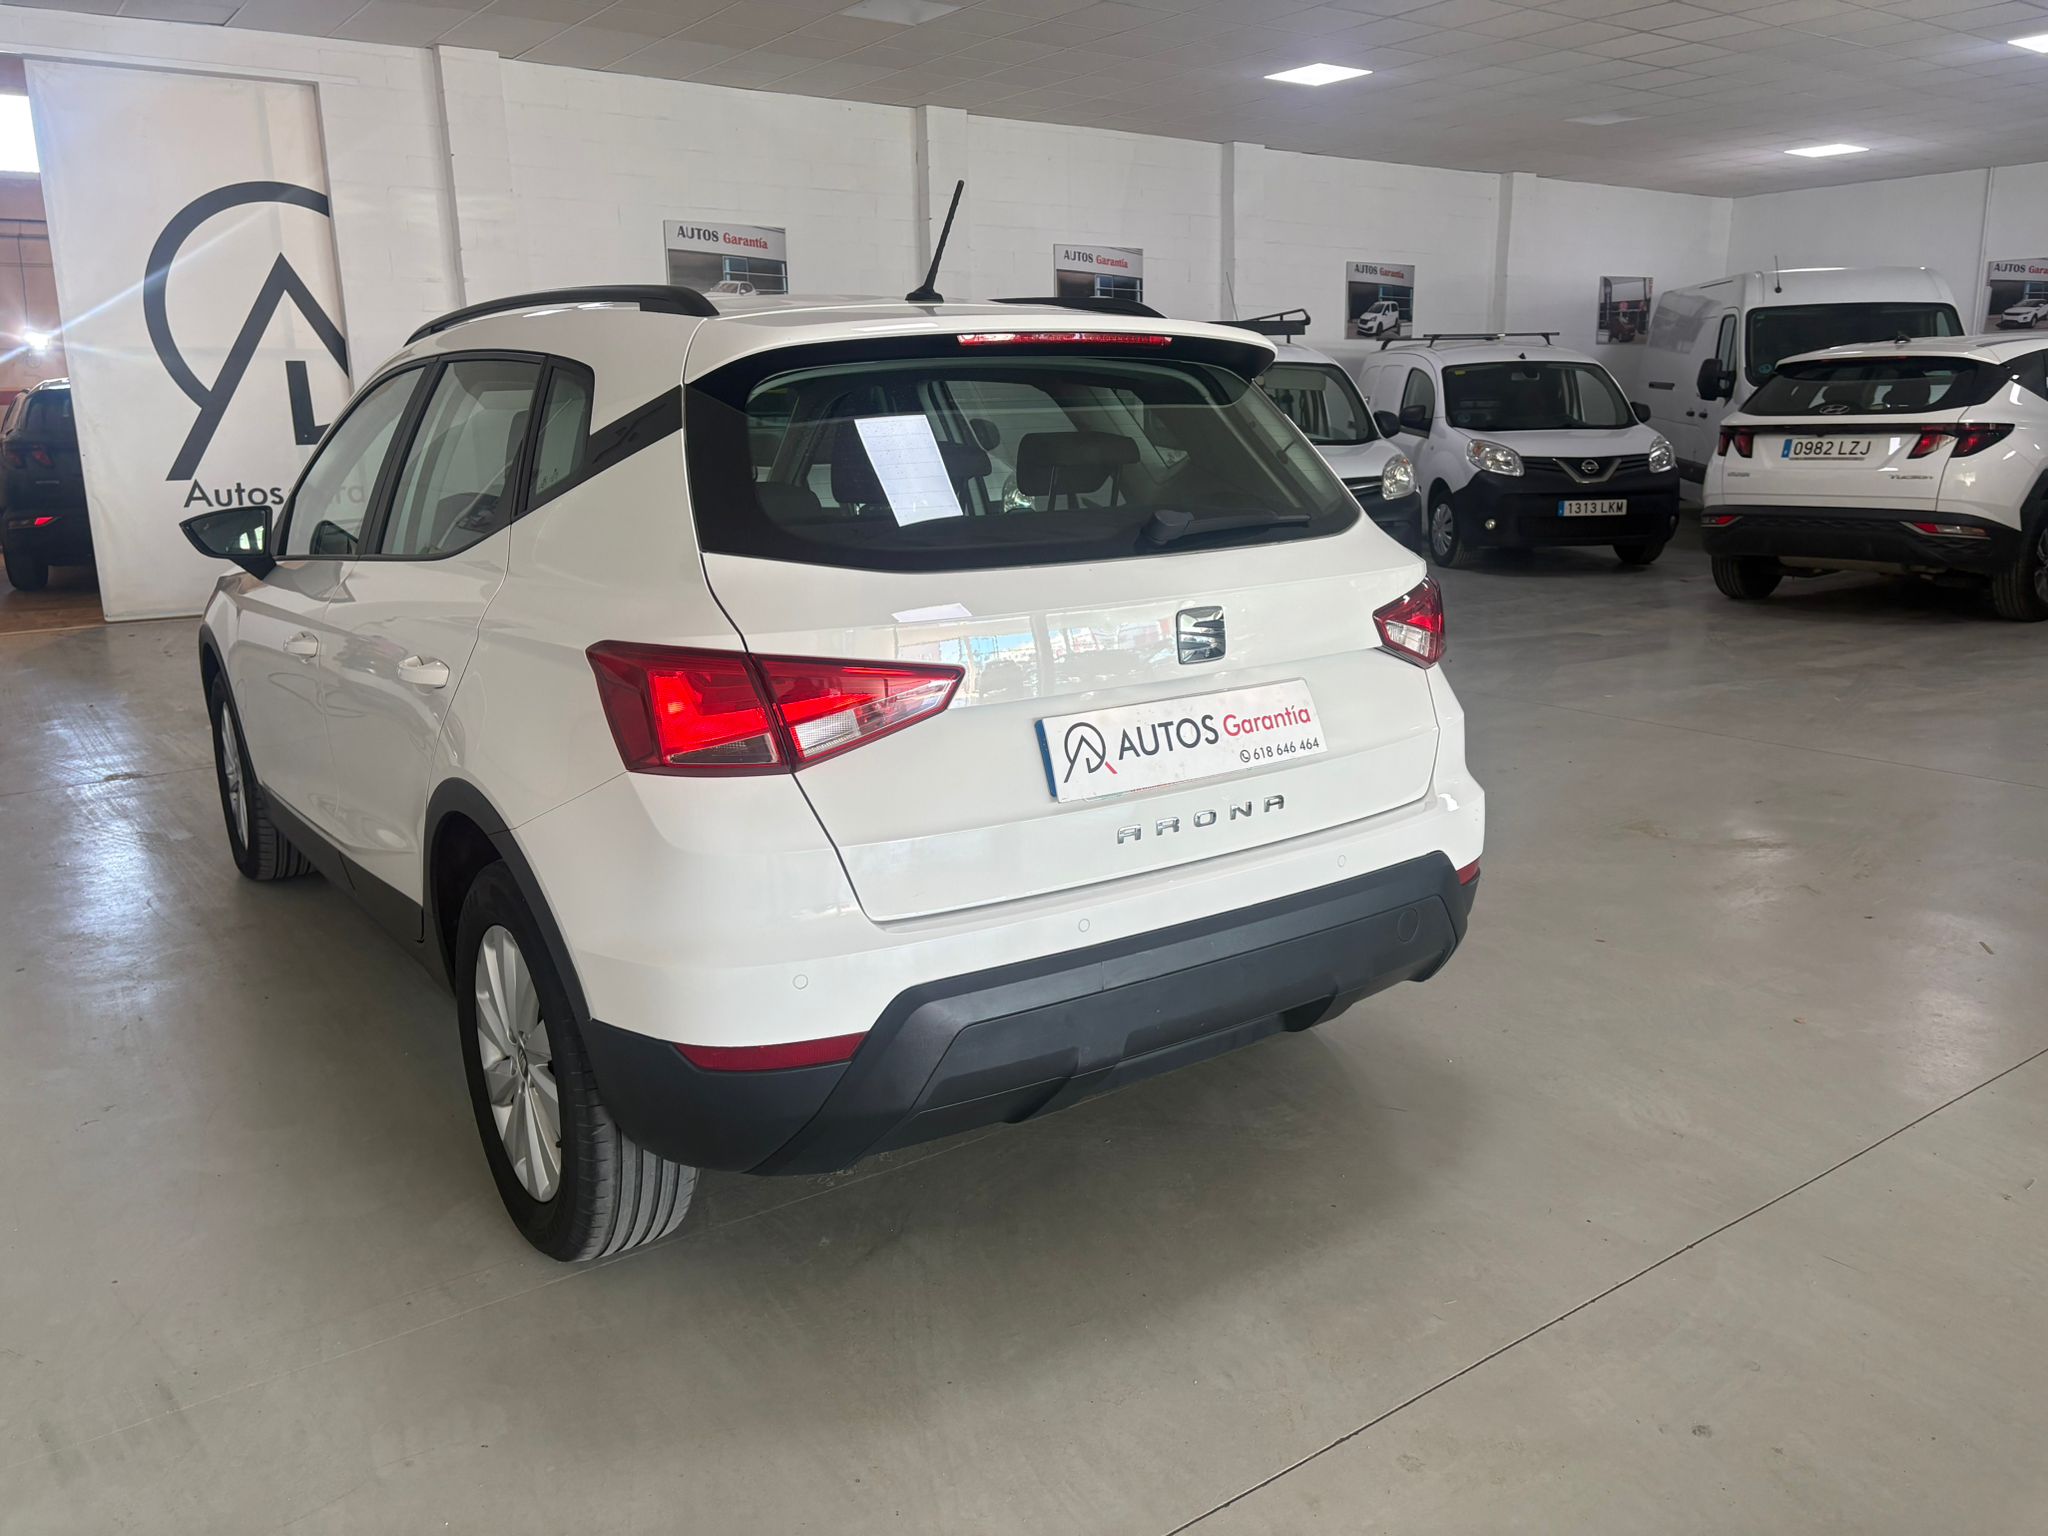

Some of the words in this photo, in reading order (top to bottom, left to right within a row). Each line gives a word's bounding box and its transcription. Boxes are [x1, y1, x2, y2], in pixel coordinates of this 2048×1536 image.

[677, 225, 719, 243] AUTOS
[722, 231, 769, 250] Garantía
[1063, 249, 1094, 264] AUTOS
[1354, 263, 1378, 275] AUTOS
[1994, 262, 2026, 274] AUTOS
[1793, 440, 1833, 456] 0982
[1837, 440, 1872, 456] LZJ
[183, 478, 285, 508] Autos
[1568, 502, 1597, 514] 1313
[1600, 501, 1624, 514] LKM
[1118, 714, 1220, 761] AUTOS
[1222, 705, 1311, 737] Garantía
[1252, 745, 1274, 760] 618
[1276, 741, 1297, 756] 646
[1299, 737, 1320, 751] 464
[1116, 794, 1285, 844] ARONA
